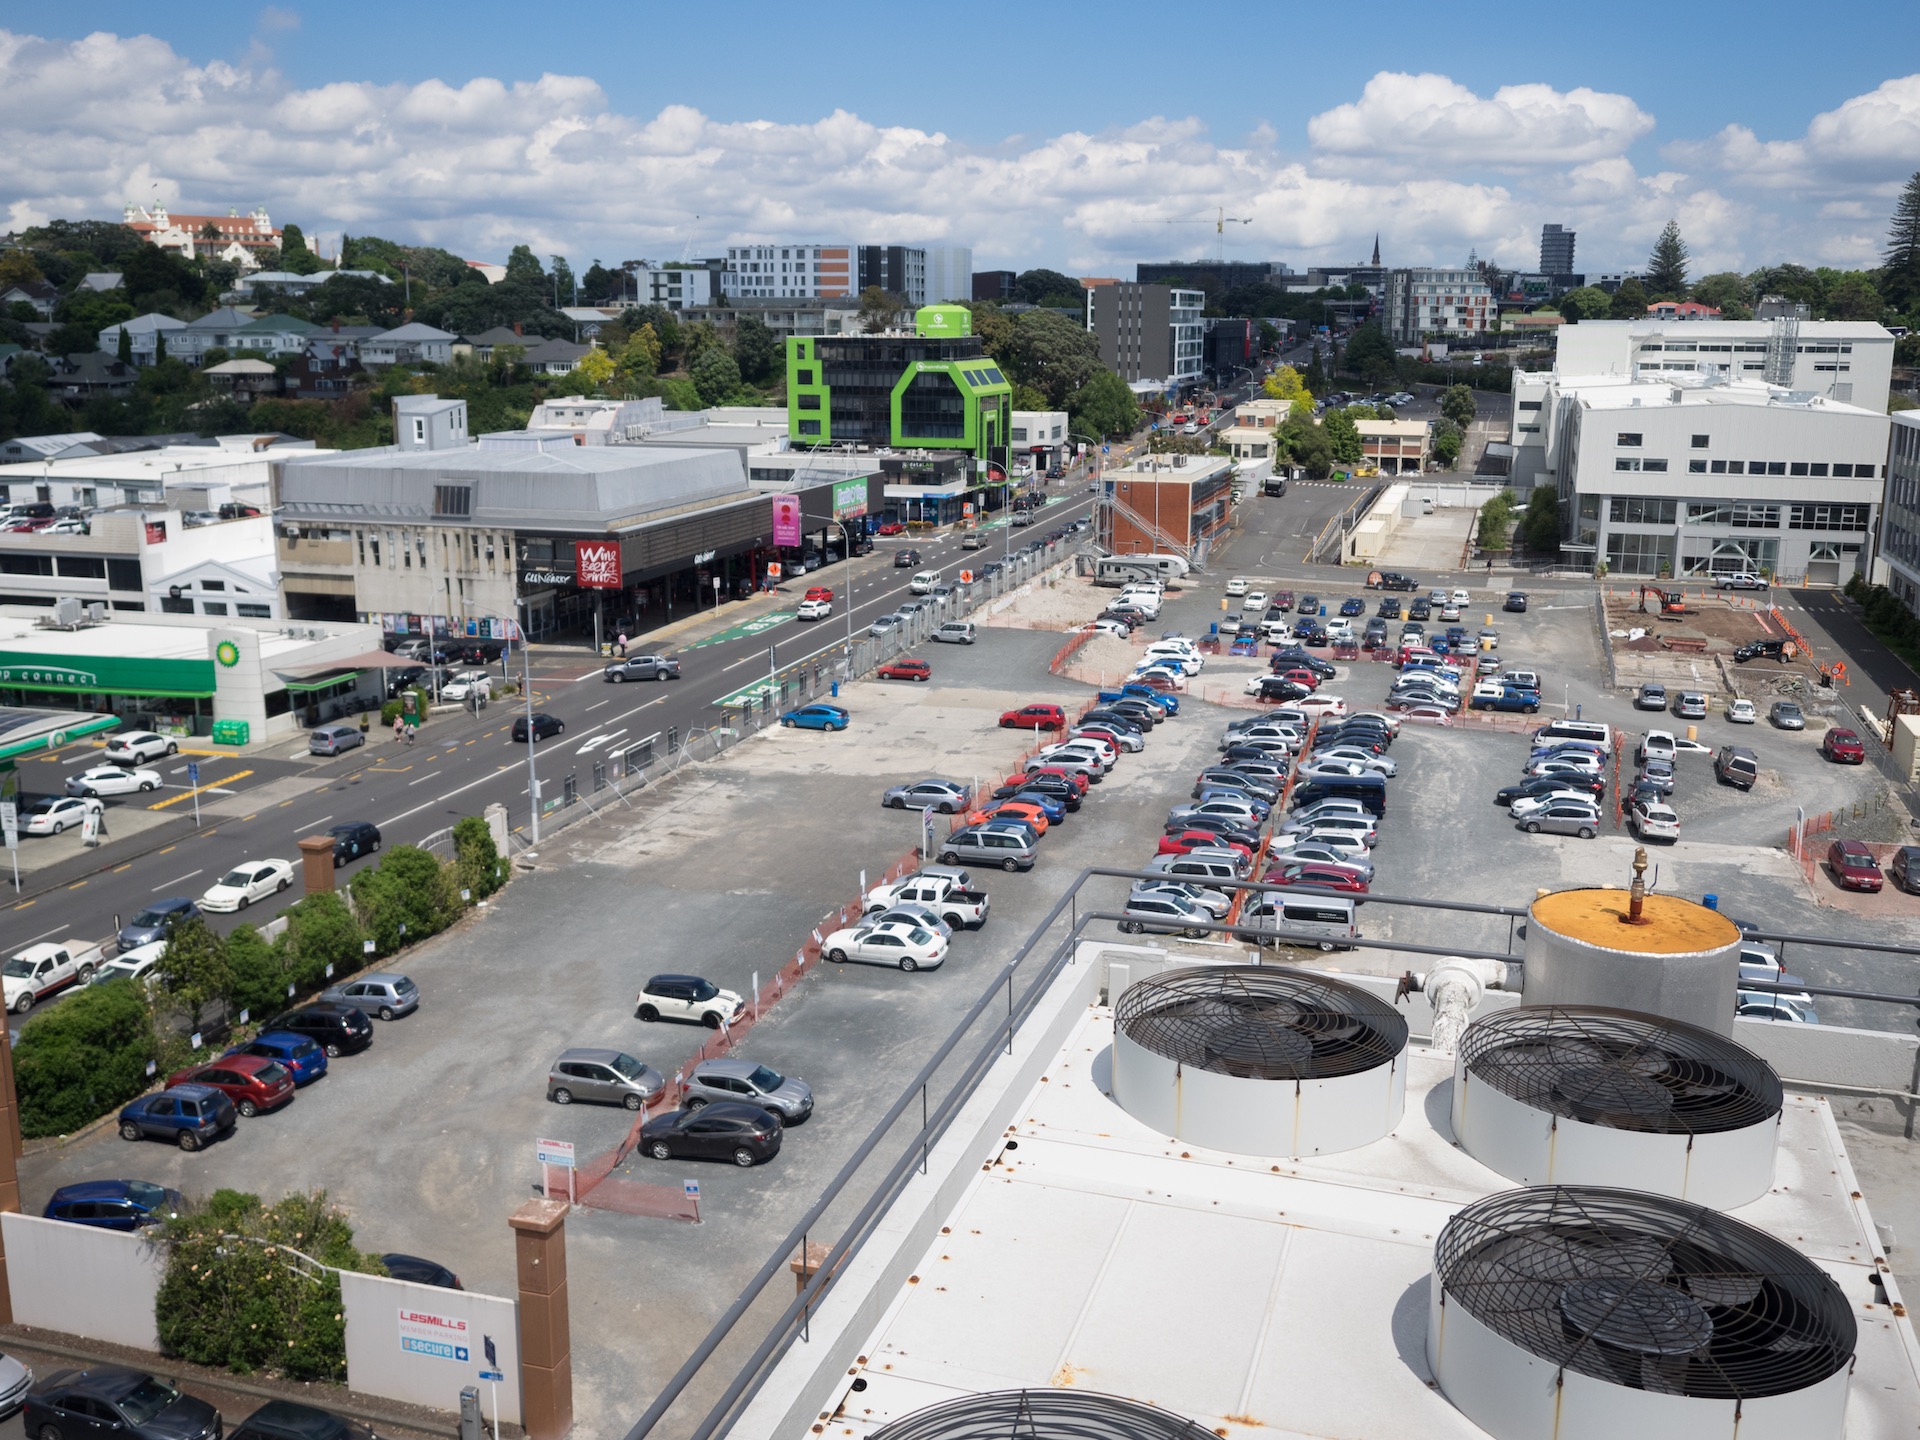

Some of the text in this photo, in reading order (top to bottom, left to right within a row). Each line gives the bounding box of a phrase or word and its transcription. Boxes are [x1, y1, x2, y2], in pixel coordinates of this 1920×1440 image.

[580, 546, 616, 562] Wine
[581, 561, 607, 572] Beer
[22, 671, 97, 684] connect
[400, 1325, 468, 1343] MEMBER PARKING
[410, 1340, 451, 1357] secure
